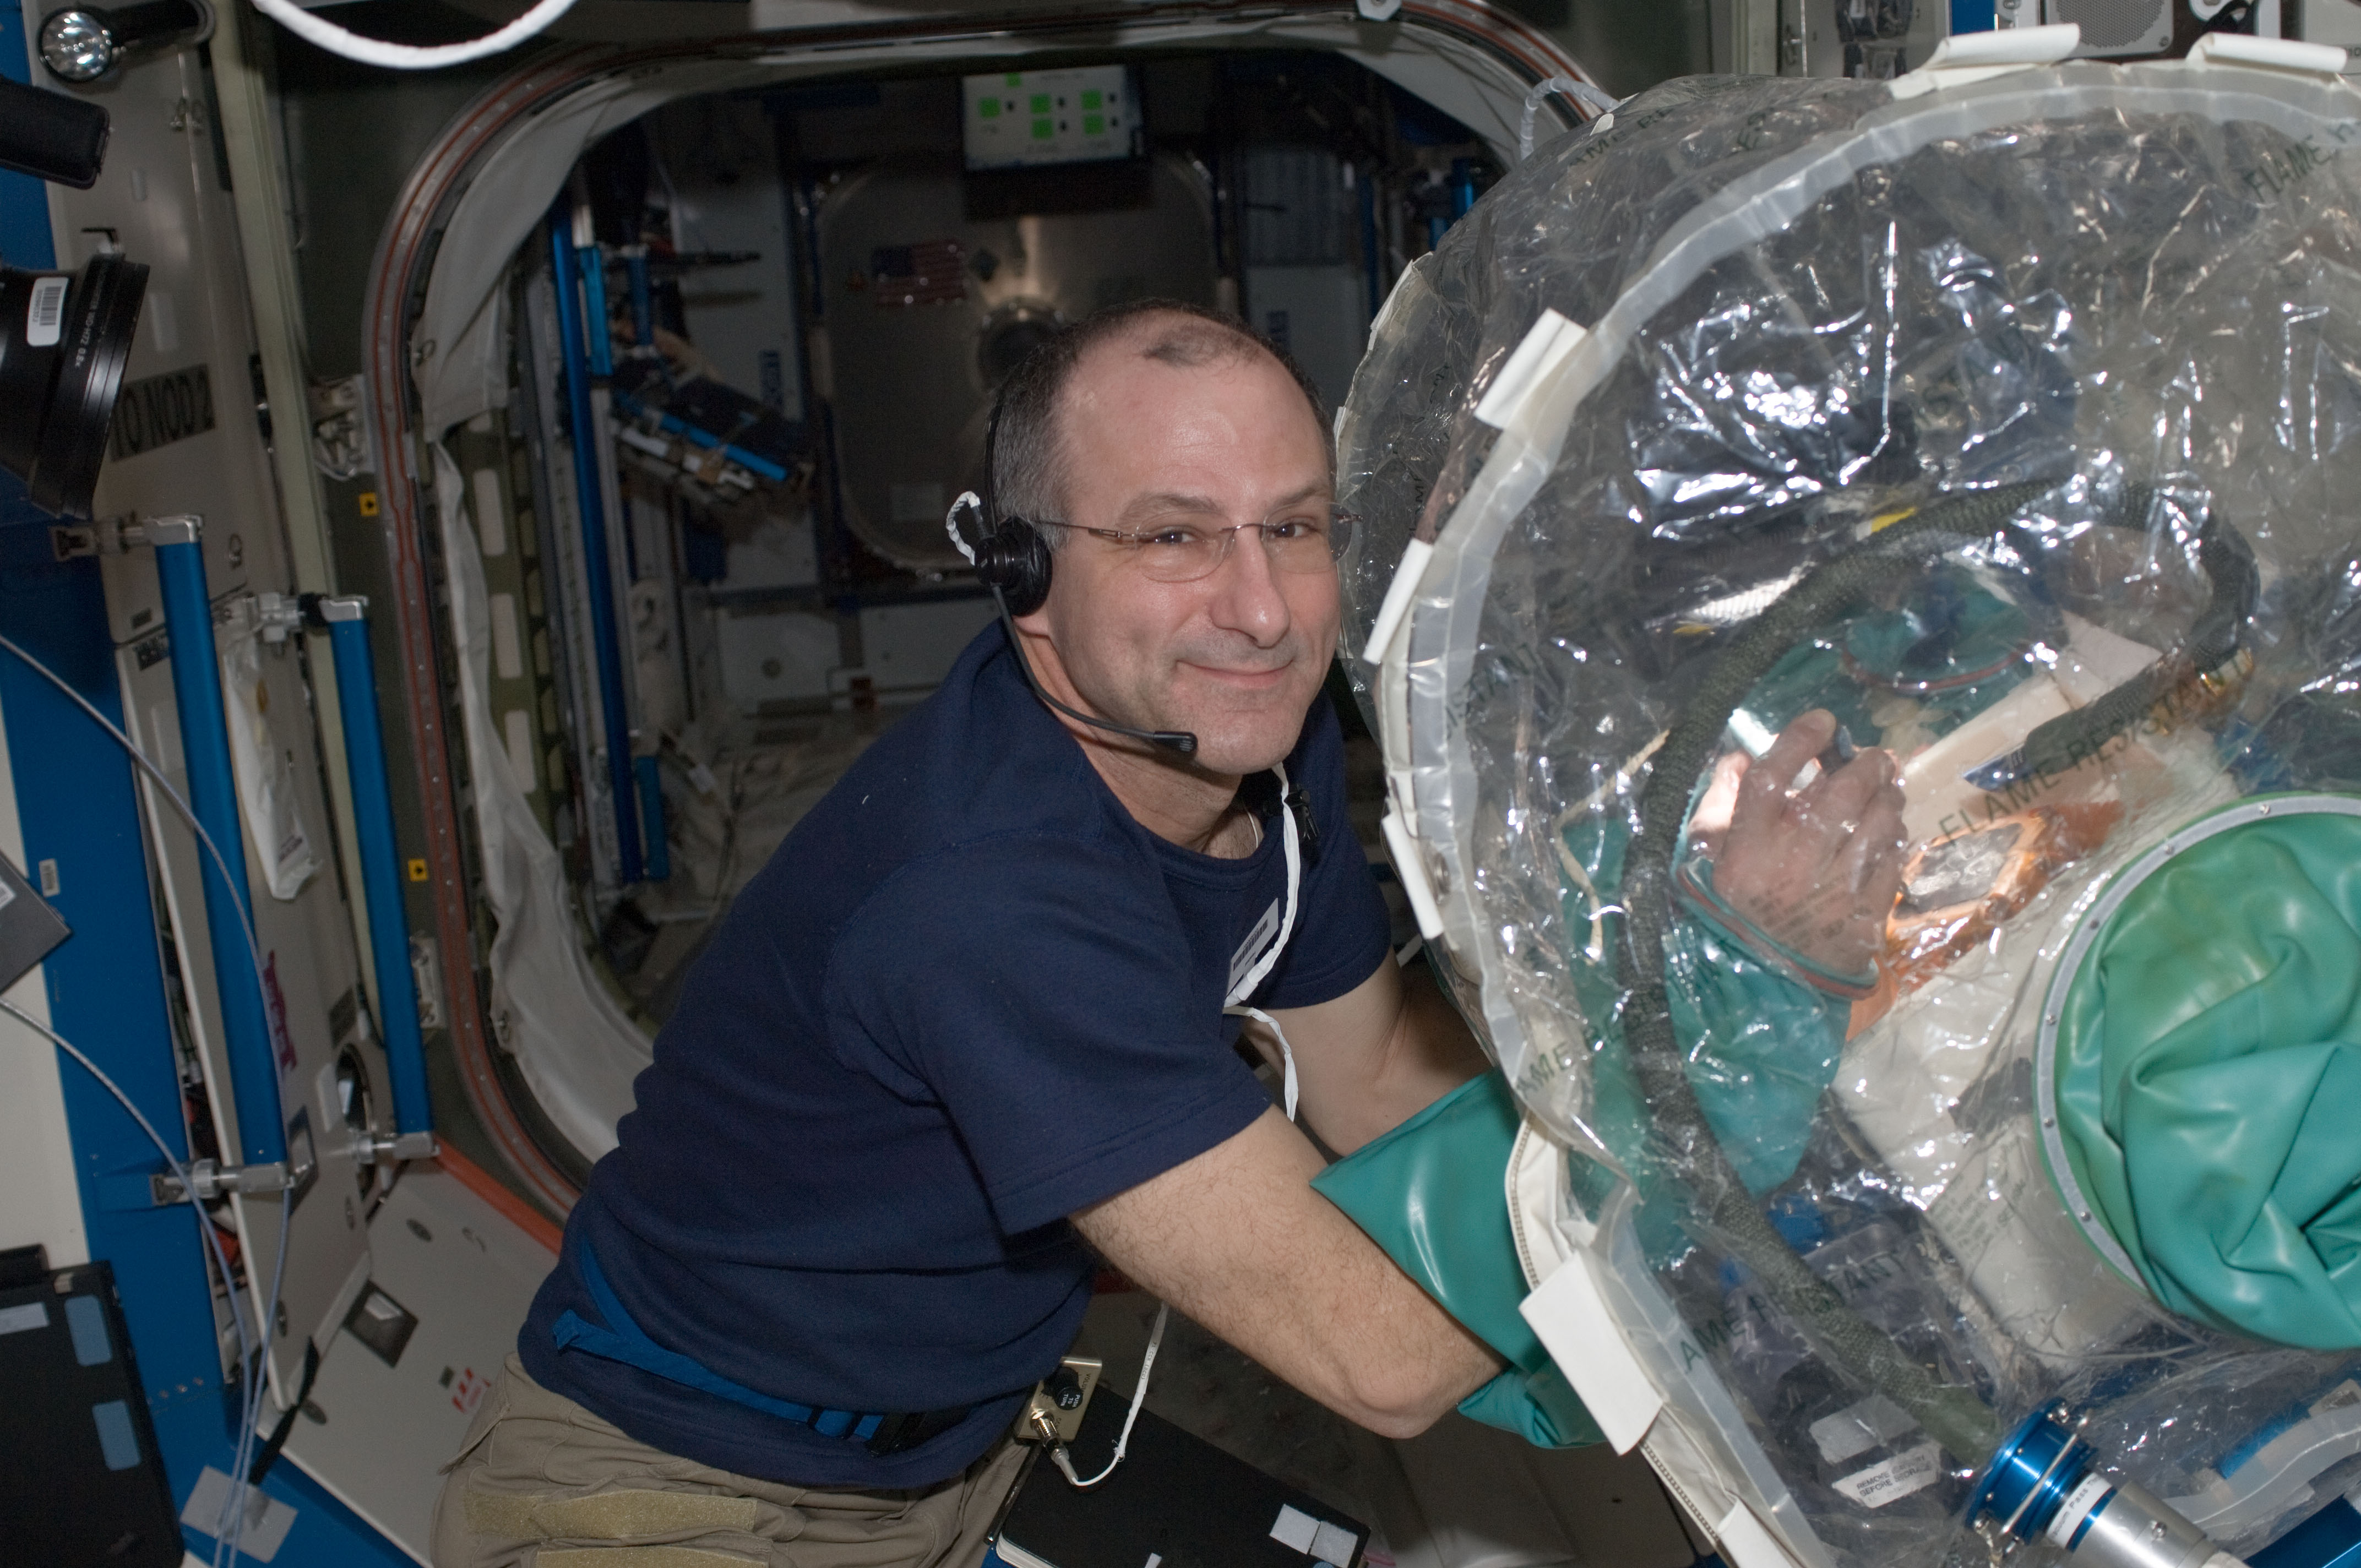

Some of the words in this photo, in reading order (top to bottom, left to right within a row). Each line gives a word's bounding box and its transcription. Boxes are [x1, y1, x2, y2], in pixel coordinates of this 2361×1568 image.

[1939, 759, 2060, 846] FLAME
[2066, 653, 2252, 772] RESISTANT
[1059, 1393, 1069, 1407] TURN
[1071, 1394, 1081, 1408] PUSH
[1857, 1471, 1890, 1490] REMOVE
[1859, 1478, 1893, 1497] BEFORE
[2069, 1488, 2088, 1509] Pass
